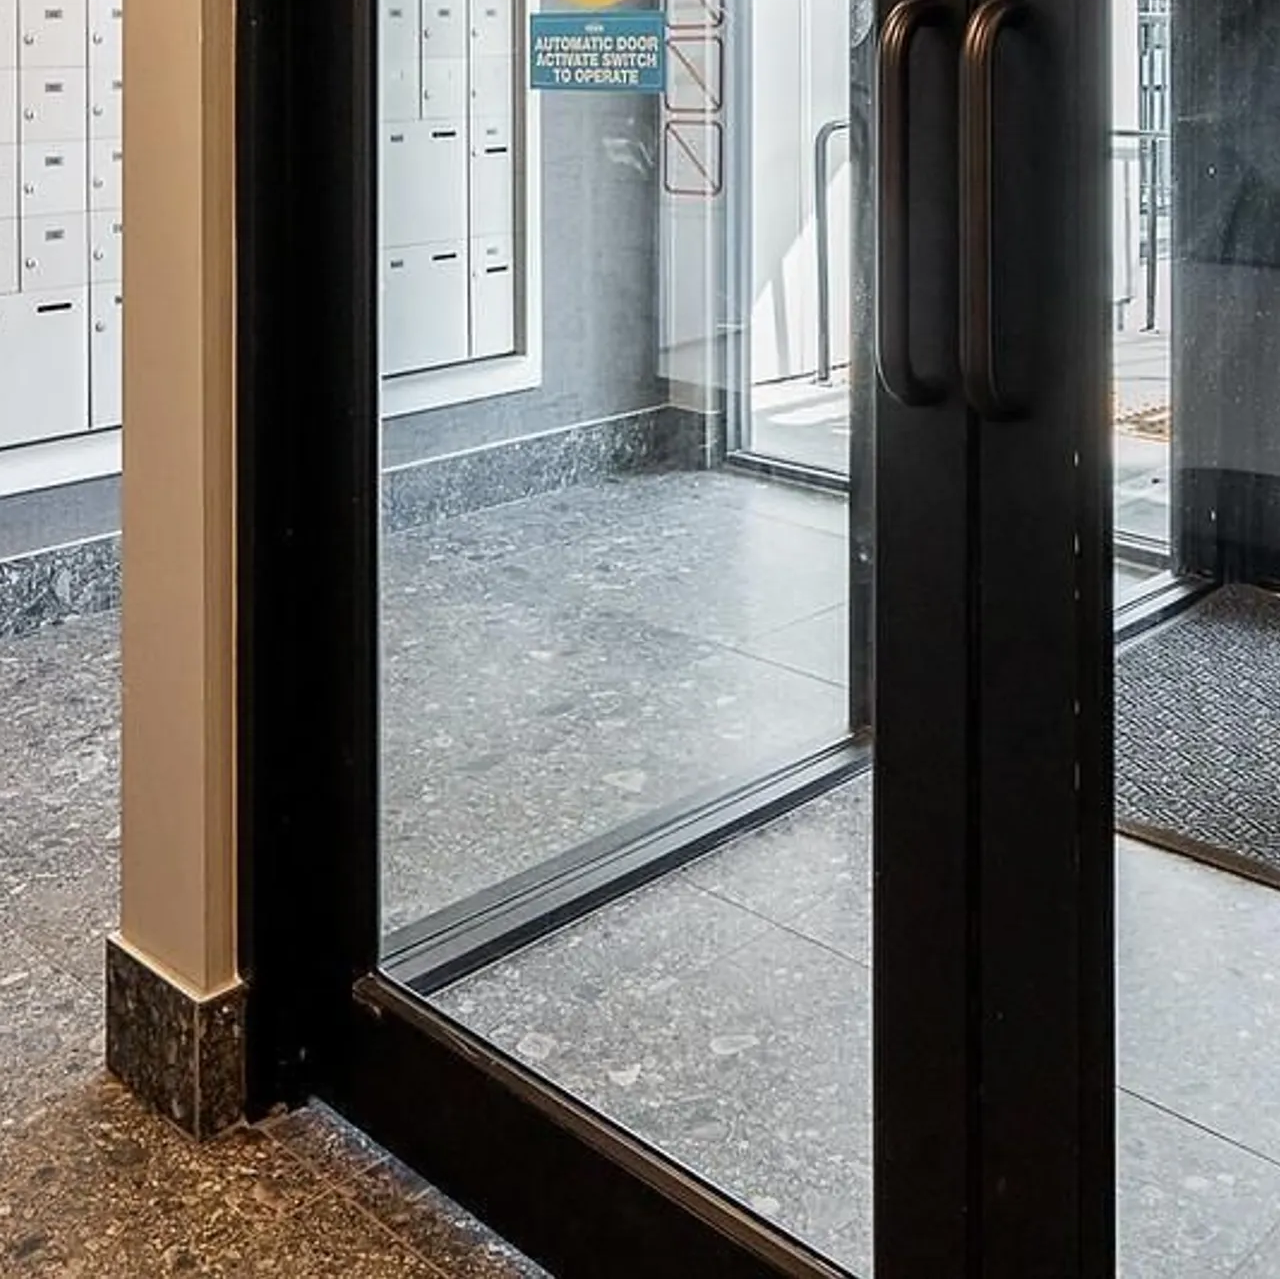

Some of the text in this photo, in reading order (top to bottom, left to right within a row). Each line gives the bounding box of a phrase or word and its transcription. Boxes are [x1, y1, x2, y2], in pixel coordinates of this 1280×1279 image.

[535, 35, 658, 52] AUTOMATIC DOOR
[536, 52, 657, 68] ACTIVATE SWITCH
[553, 68, 640, 84] TO OPERATE
